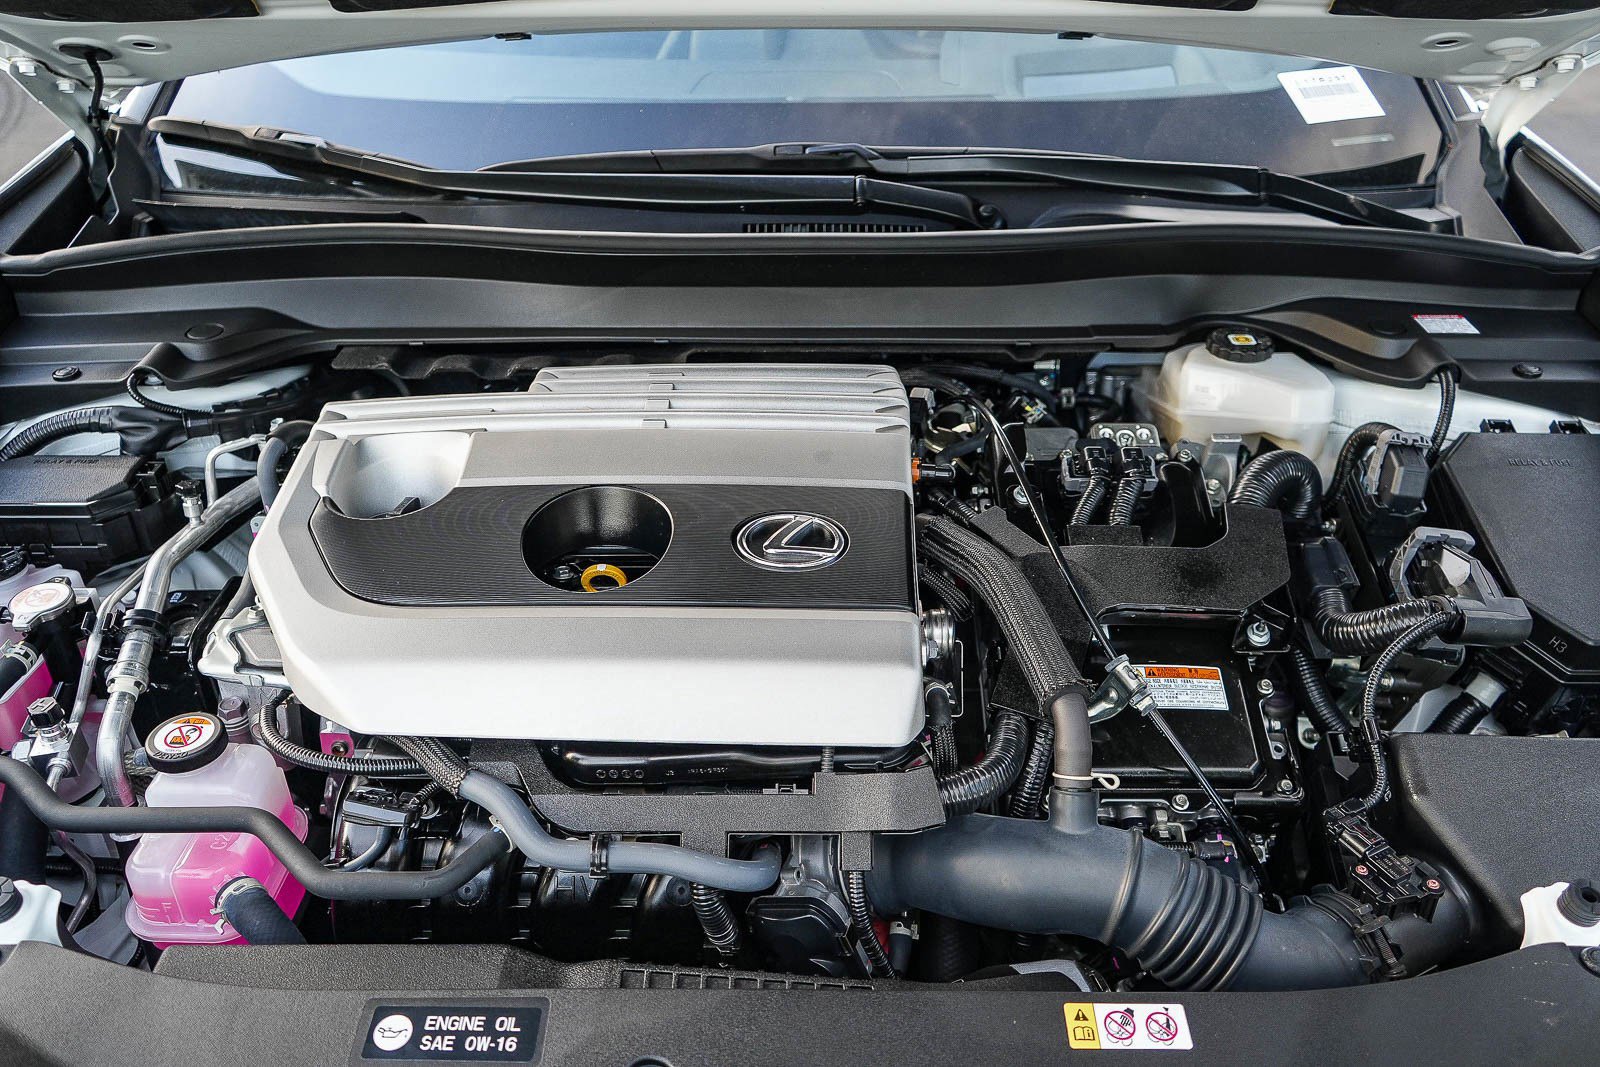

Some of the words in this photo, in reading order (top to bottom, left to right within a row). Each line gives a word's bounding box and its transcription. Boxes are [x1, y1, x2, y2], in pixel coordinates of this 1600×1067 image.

[1549, 636, 1567, 652] H3
[555, 875, 599, 901] HV
[424, 1016, 486, 1032] ENGINE
[495, 1017, 521, 1032] OIL
[419, 1035, 456, 1051] SAE
[464, 1036, 518, 1052] 0W-16
